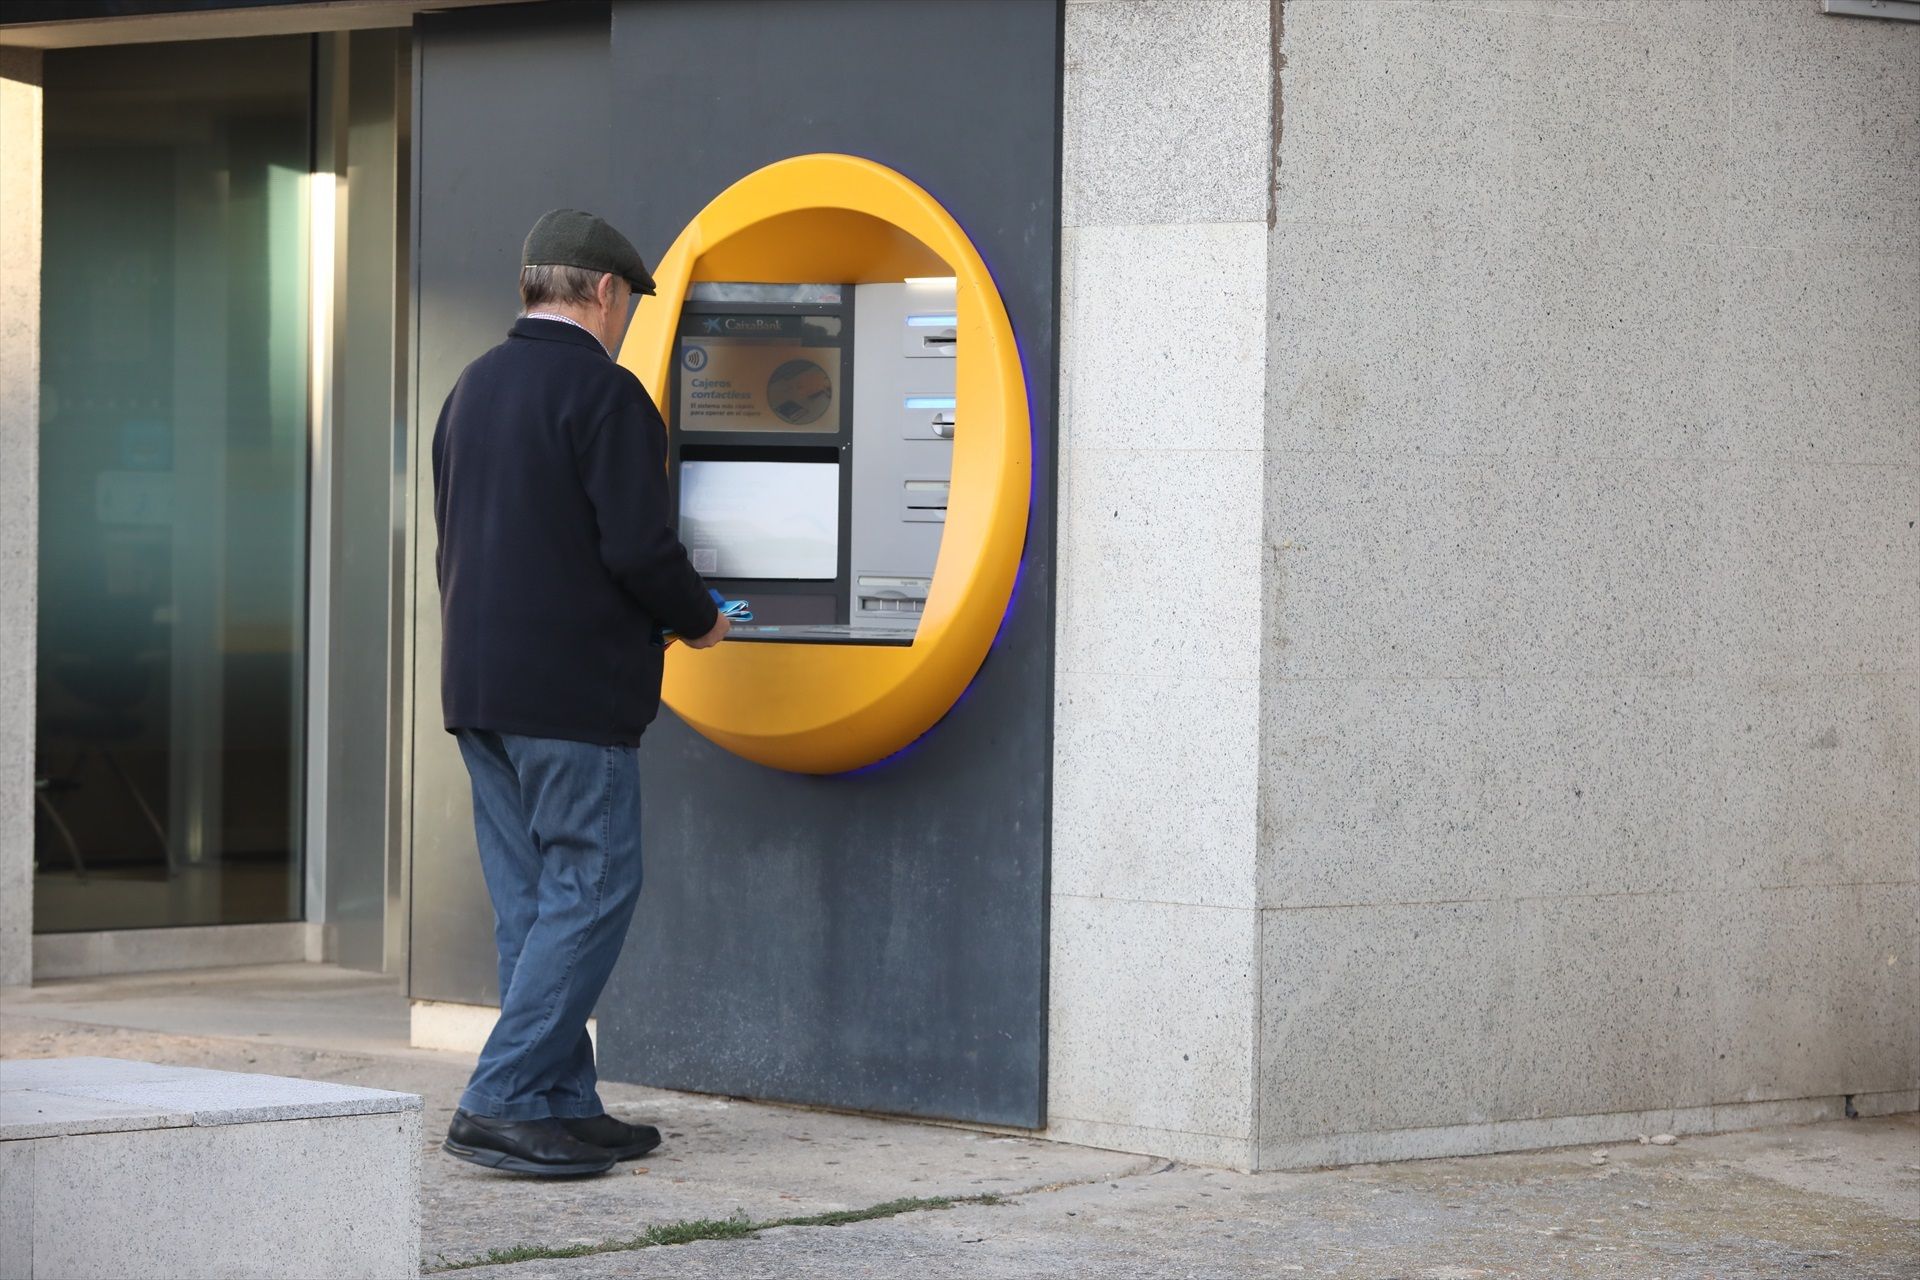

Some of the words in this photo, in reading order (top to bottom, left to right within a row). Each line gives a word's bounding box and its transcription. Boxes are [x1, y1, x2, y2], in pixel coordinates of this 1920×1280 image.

[725, 318, 783, 330] CaixaBank
[691, 378, 732, 389] Cajeros
[691, 390, 752, 399] contactless
